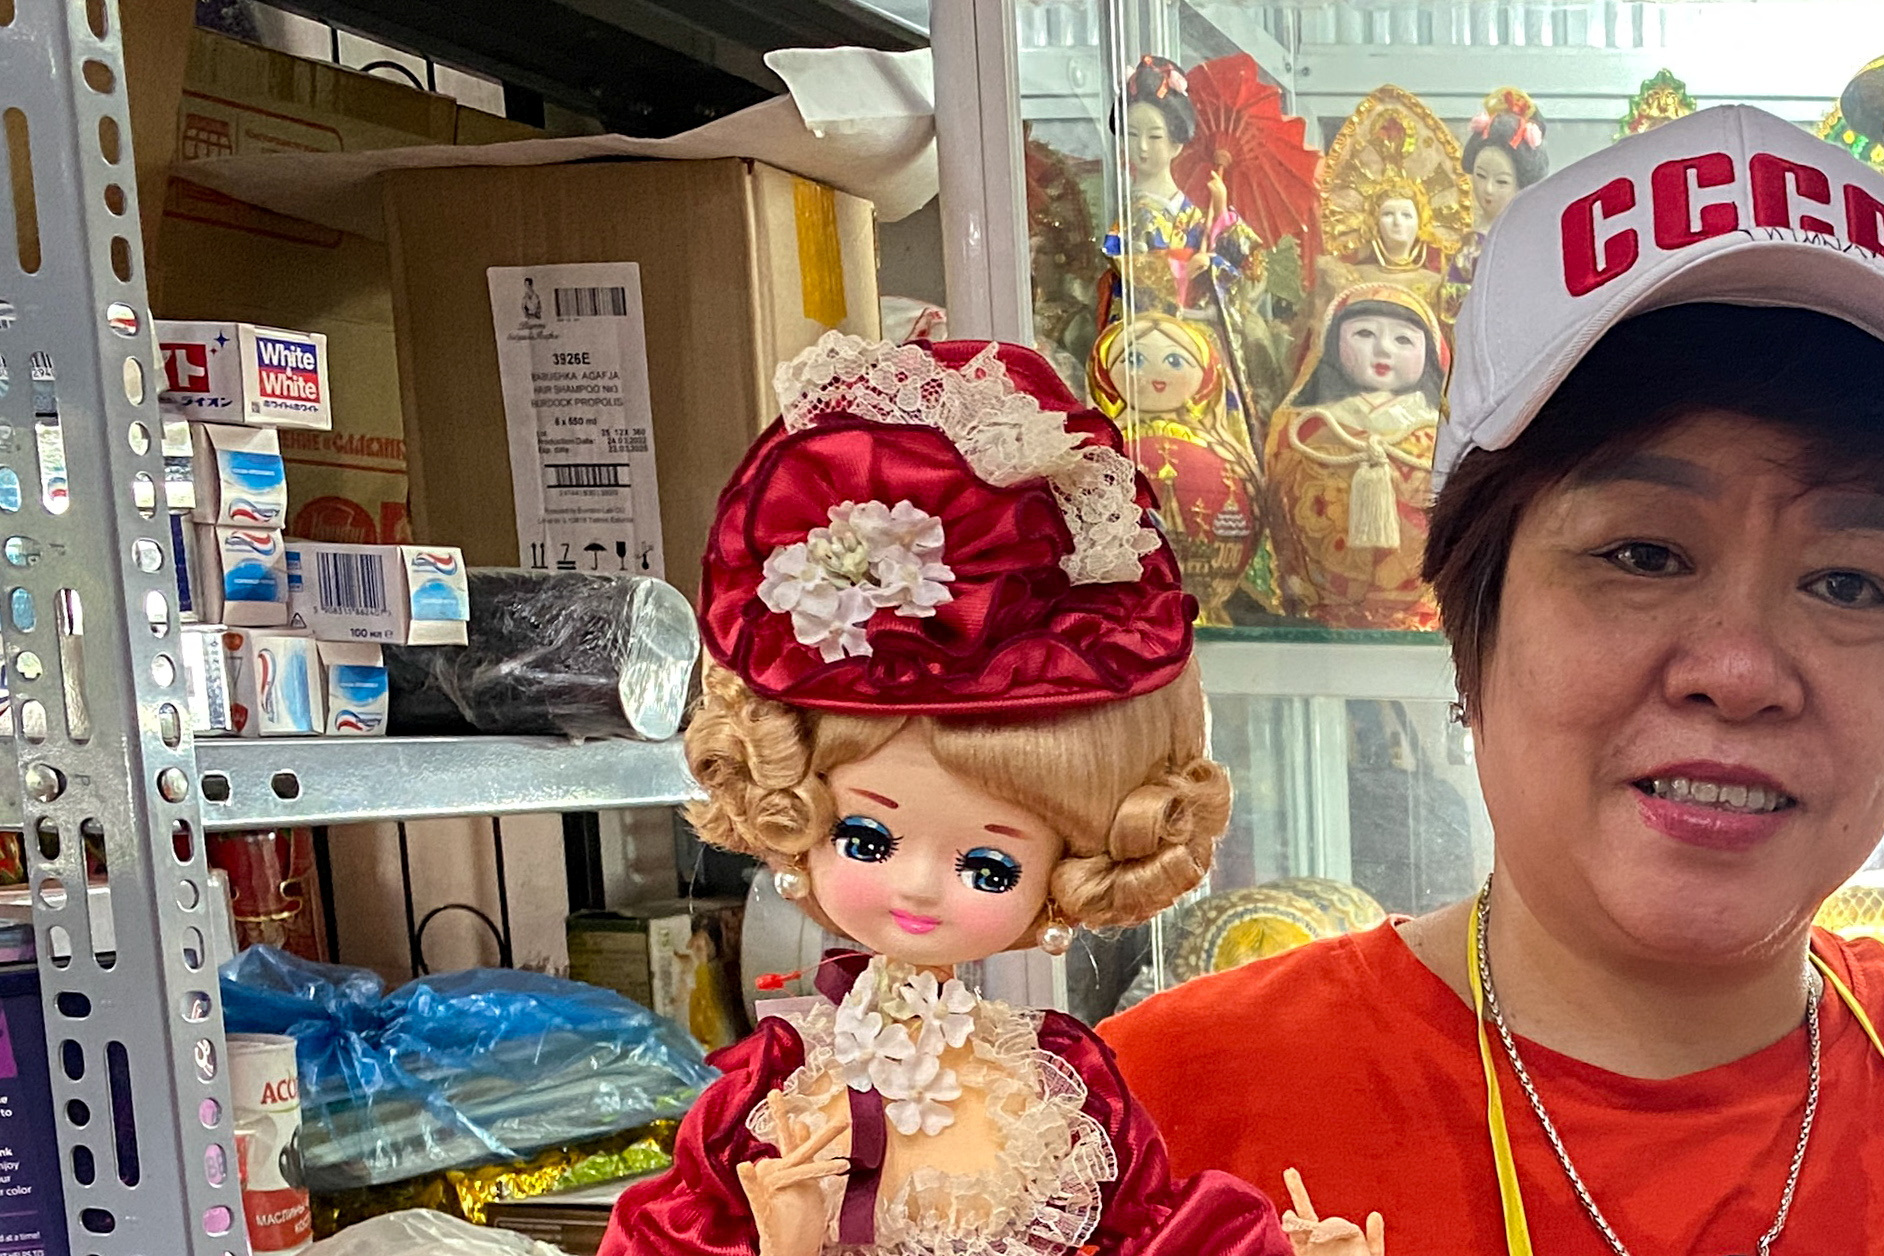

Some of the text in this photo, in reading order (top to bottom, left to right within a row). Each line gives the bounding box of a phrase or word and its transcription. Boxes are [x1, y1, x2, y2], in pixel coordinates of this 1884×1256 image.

[258, 340, 316, 371] White
[552, 352, 591, 366] 3926E
[260, 371, 318, 401] White
[553, 384, 600, 394] SHAMPOO
[575, 397, 624, 408] PROPOLIS
[349, 627, 369, 640] 100
[6, 1185, 32, 1197] color
